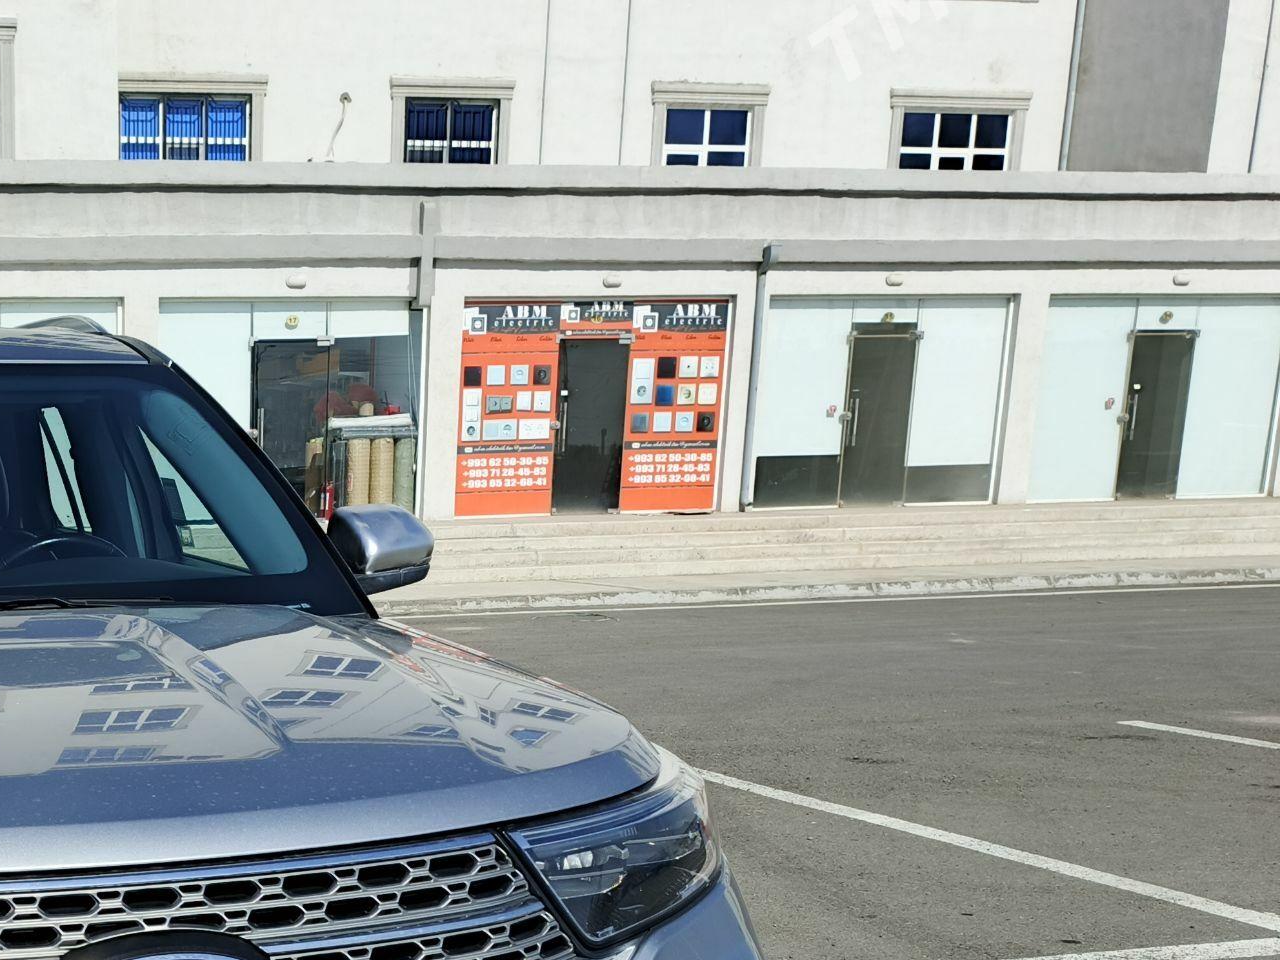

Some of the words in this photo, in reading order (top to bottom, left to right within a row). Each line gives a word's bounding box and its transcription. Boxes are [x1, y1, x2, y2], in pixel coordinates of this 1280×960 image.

[502, 305, 547, 318] ABM
[672, 304, 717, 316] ABM
[494, 318, 554, 327] electric
[665, 317, 723, 325] electric
[490, 468, 501, 477] 71
[655, 464, 666, 472] 71
